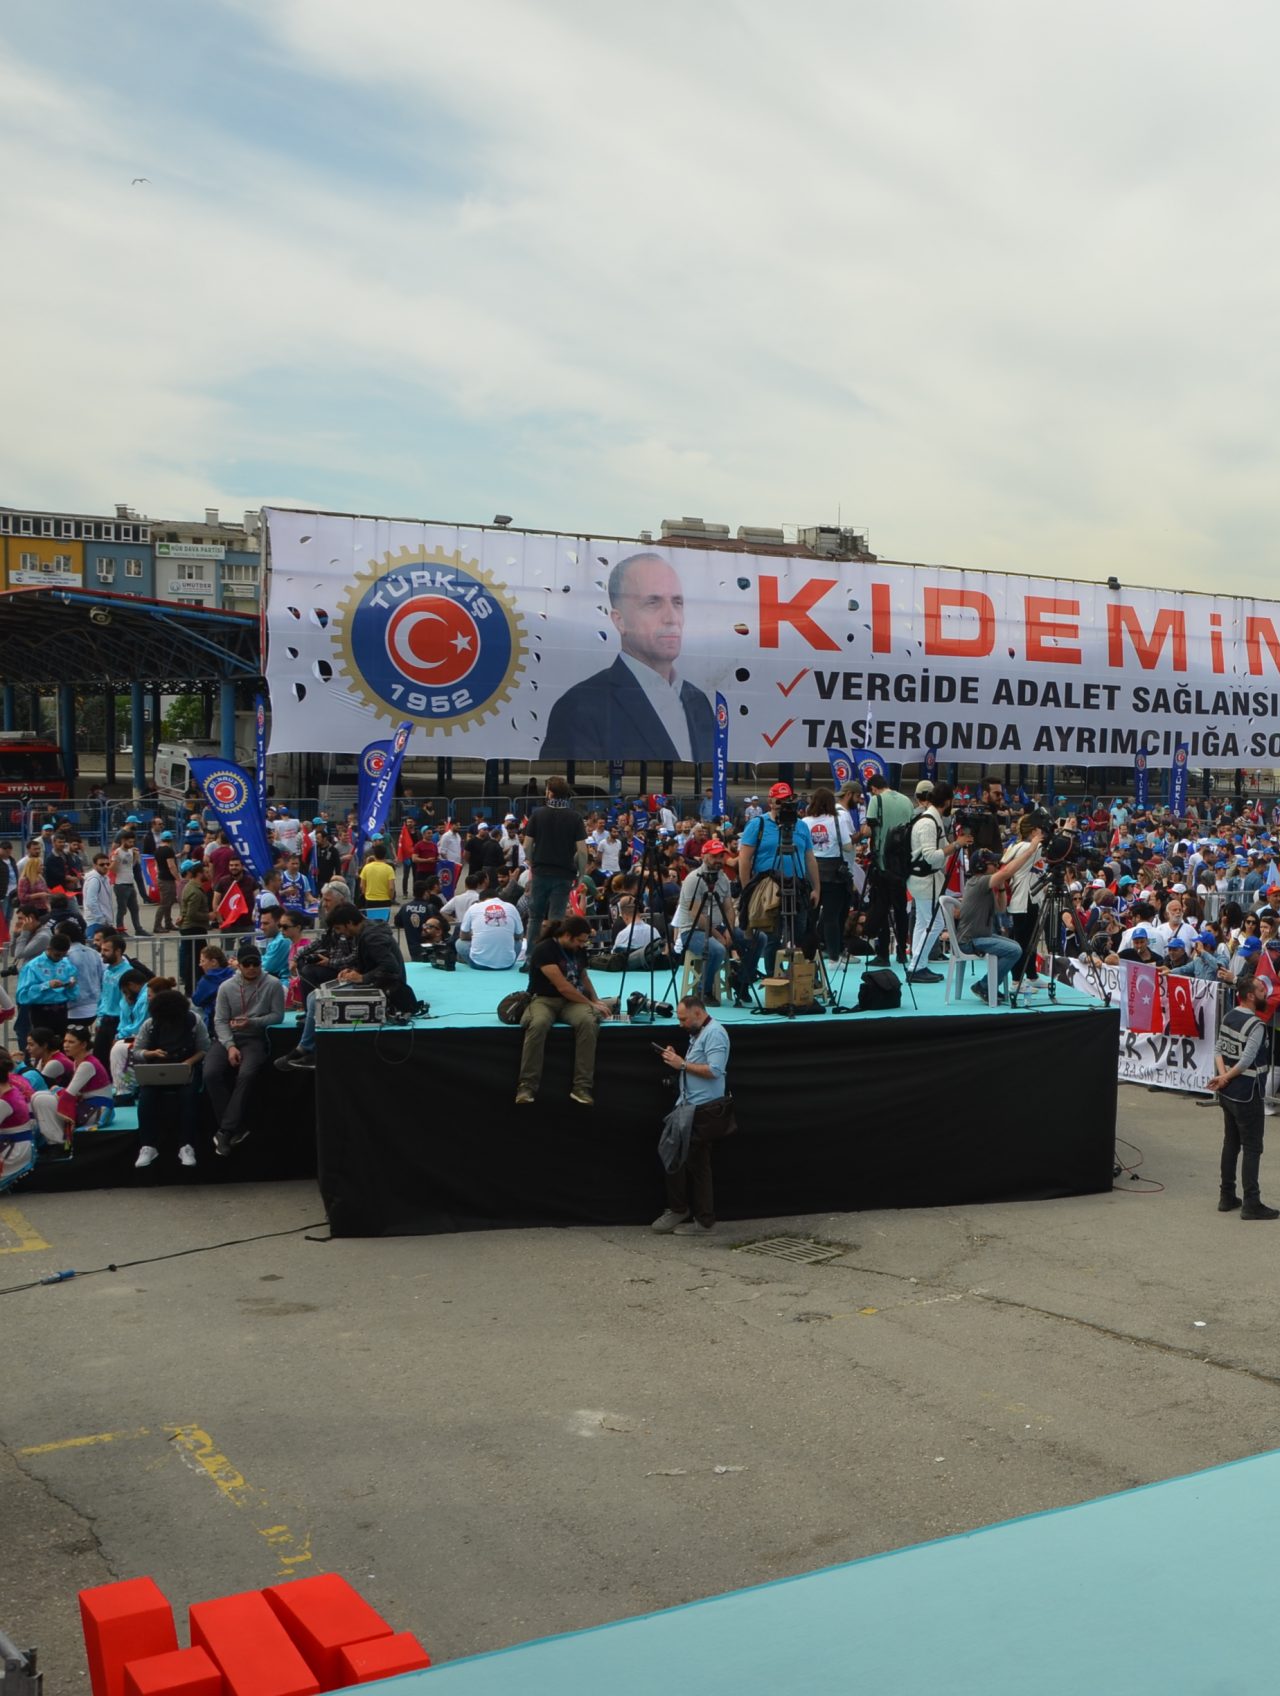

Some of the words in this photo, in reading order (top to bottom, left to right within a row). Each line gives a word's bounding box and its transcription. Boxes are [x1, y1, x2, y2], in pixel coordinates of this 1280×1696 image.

[369, 570, 493, 619] TÜRK-İŞ
[391, 684, 473, 713] 1952
[814, 667, 979, 704] VERGİDE
[992, 678, 1121, 711] ADALET
[1033, 725, 1239, 758] AYRIMCILIĞA
[1147, 1036, 1198, 1071] VER
